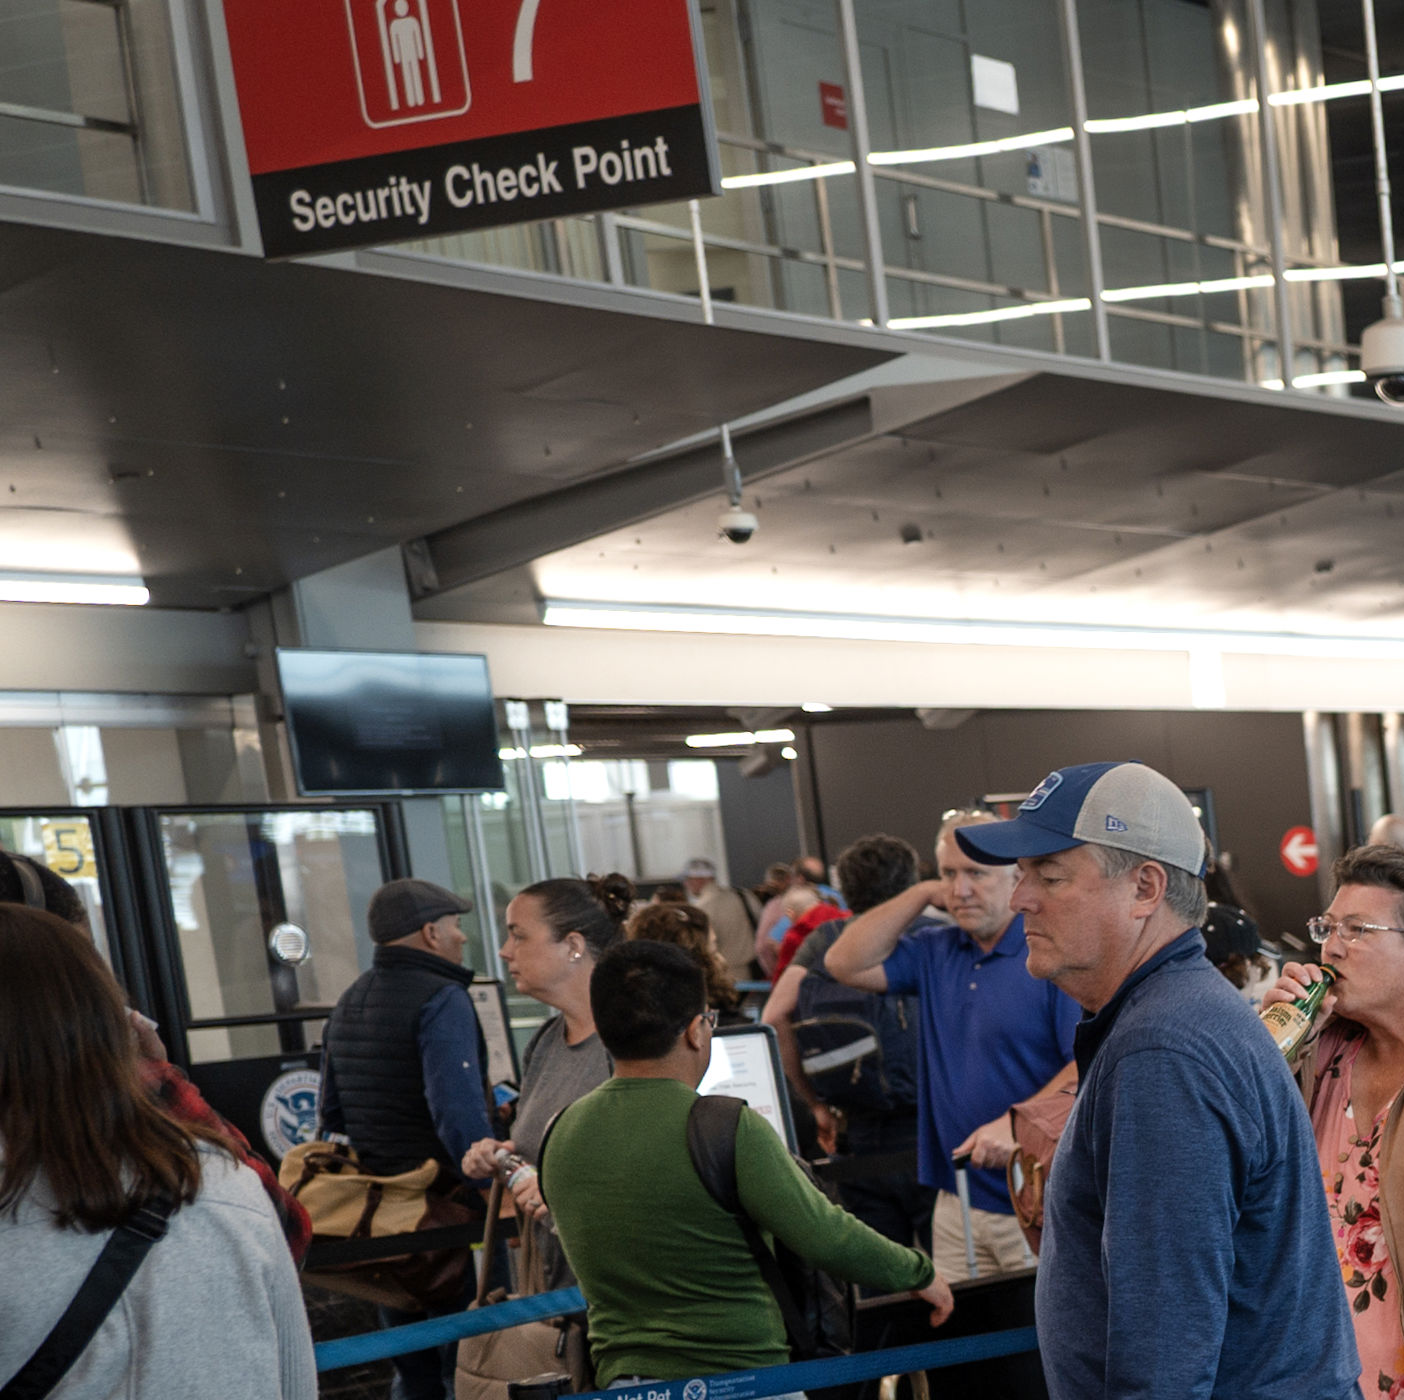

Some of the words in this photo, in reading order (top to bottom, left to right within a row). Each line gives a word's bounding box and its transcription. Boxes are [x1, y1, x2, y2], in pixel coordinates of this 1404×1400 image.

[289, 175, 432, 232] Security
[444, 152, 564, 209] Check
[571, 136, 673, 189] Point
[55, 829, 84, 874] 5
